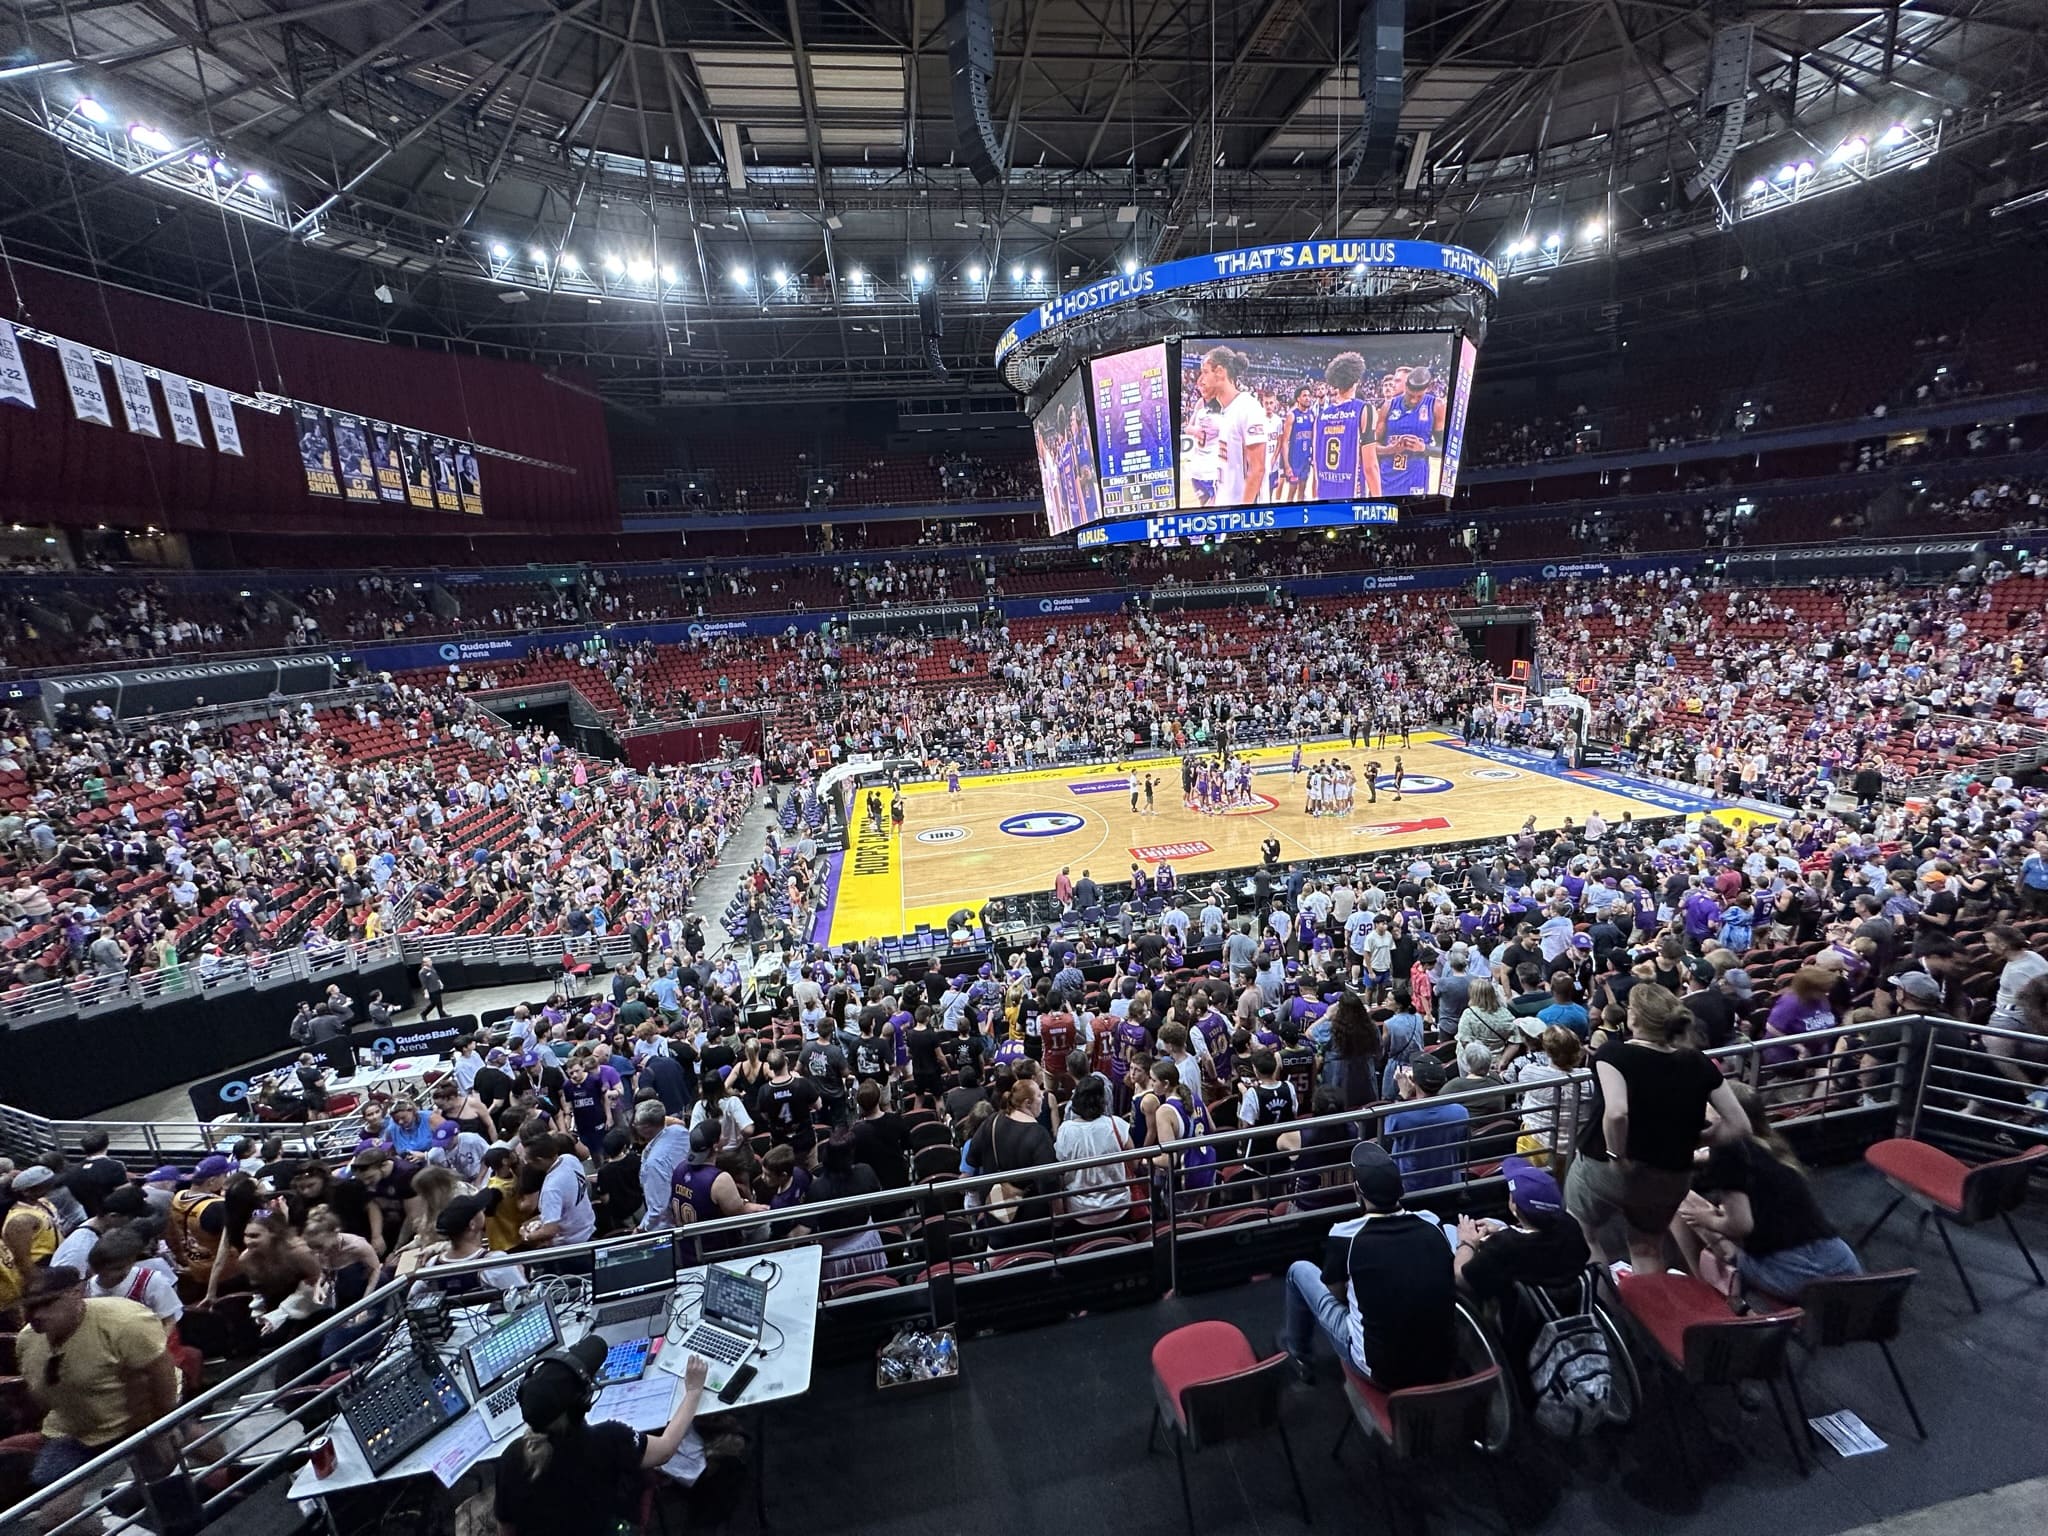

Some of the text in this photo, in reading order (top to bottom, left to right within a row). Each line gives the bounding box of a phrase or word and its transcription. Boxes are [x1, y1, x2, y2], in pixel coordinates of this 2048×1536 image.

[1214, 246, 1294, 274] THAT'S
[1299, 245, 1313, 266] A
[1441, 248, 1480, 276] THAT'S
[1064, 271, 1154, 315] HOSTPLUS
[72, 385, 102, 402] 92-93
[308, 481, 340, 495] SMITH
[352, 478, 368, 490] CJ
[437, 493, 459, 505] BOB
[1352, 505, 1387, 521] THAT'S
[1178, 510, 1275, 535] HOSTPLUS
[460, 640, 512, 651] Qudos Bank
[462, 650, 489, 659] Arena
[853, 844, 889, 876] HOOPS
[1359, 923, 1373, 936] 92
[395, 1027, 459, 1045] Qudos Bank
[398, 1042, 428, 1053] Arena
[778, 1103, 792, 1123] 4
